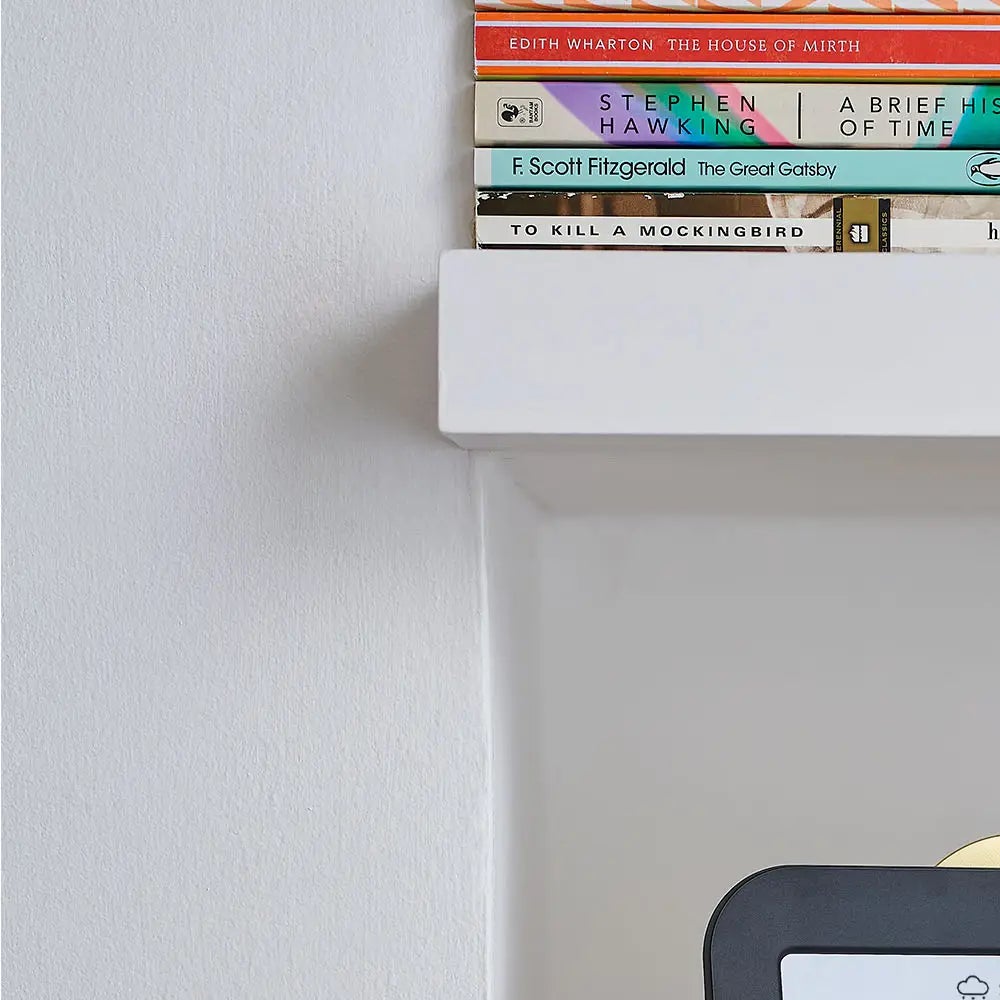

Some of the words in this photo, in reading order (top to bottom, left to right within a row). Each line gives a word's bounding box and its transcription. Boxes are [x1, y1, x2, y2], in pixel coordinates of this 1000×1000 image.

[510, 36, 558, 49] EDITH
[568, 39, 652, 50] WHARTON
[668, 39, 700, 50] THE
[709, 39, 767, 51] HOUSE
[774, 40, 795, 51] OF
[803, 40, 859, 52] MIRTH
[600, 94, 754, 112] STEPHEN
[840, 97, 854, 112] A
[871, 97, 945, 113] BRIEF
[601, 118, 754, 137] HAWKING
[840, 120, 874, 136] OF
[889, 120, 955, 138] TIME
[513, 158, 523, 174] F.
[530, 157, 582, 175] Scott
[589, 158, 685, 180] Fitzgerald
[698, 162, 725, 175] The
[730, 162, 775, 176] Great
[779, 162, 836, 179] Gatsby
[511, 225, 537, 235] TO
[552, 225, 599, 235] KILL
[613, 226, 625, 236] A
[640, 226, 803, 237] MOCKINGBIRD
